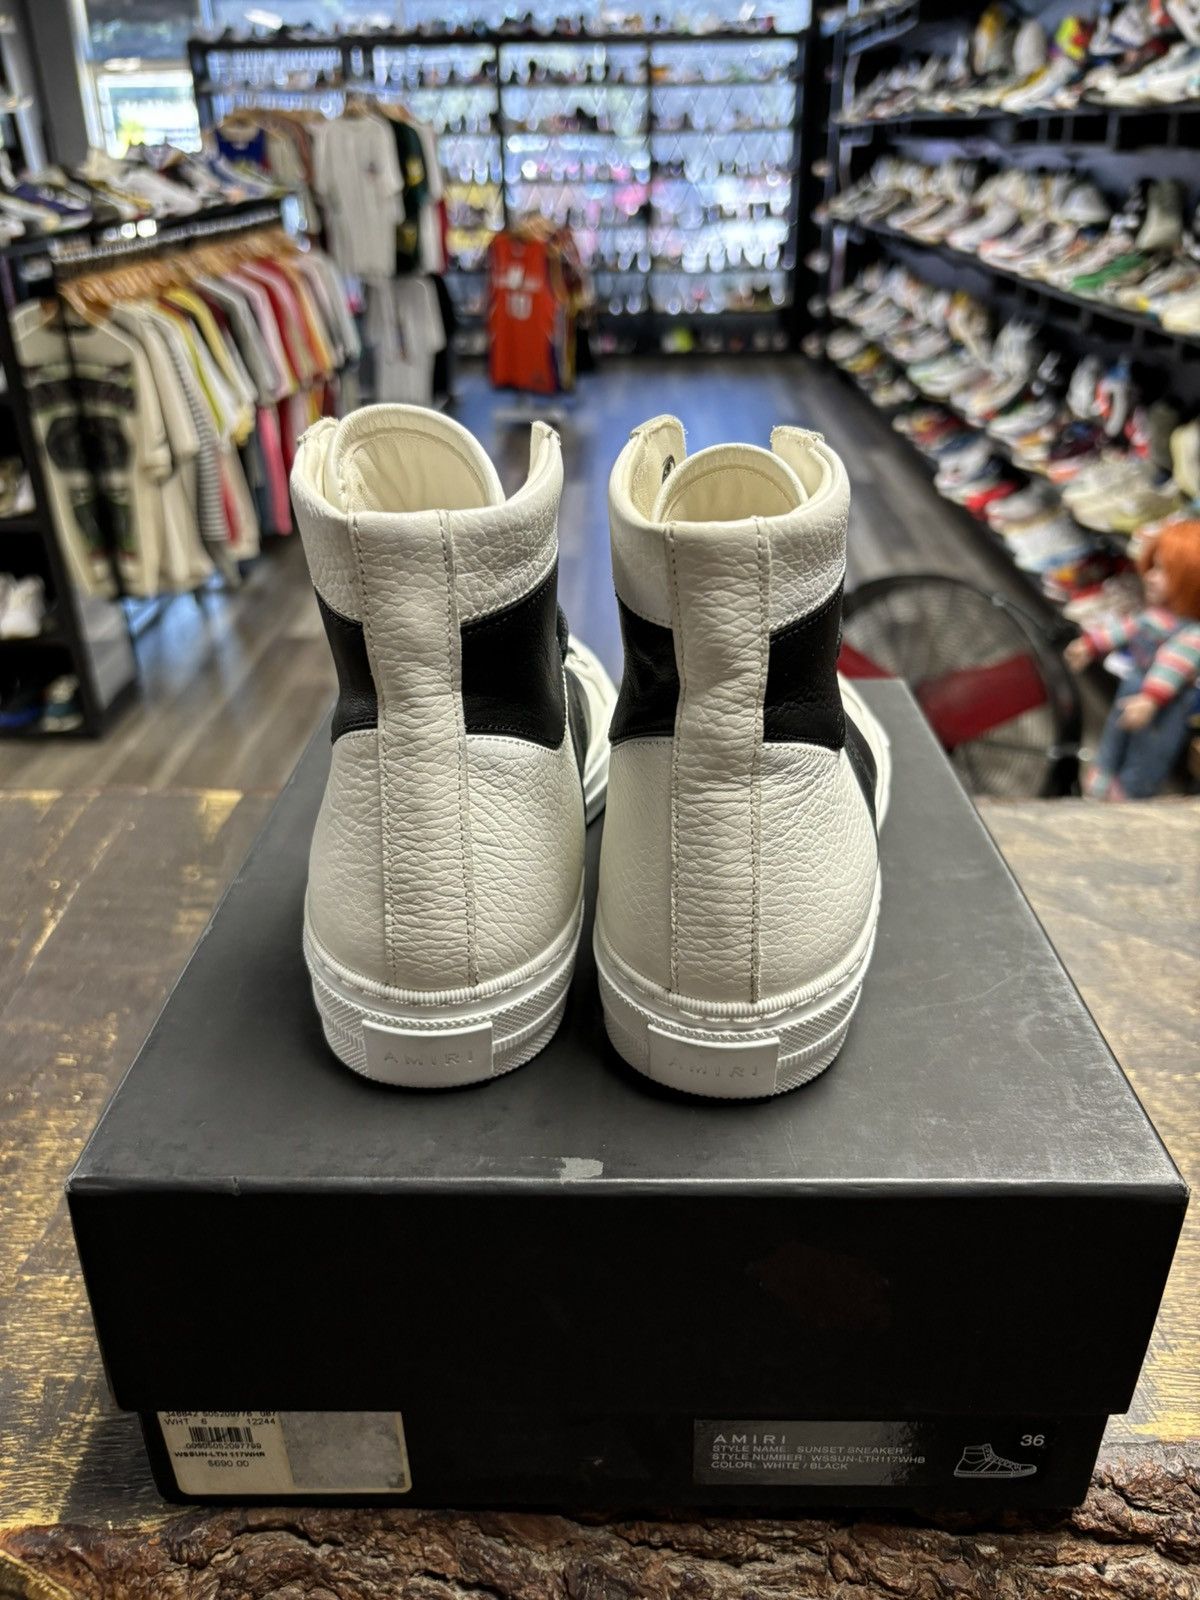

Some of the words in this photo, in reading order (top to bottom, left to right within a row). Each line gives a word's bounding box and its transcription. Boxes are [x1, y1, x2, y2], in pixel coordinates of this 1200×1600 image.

[384, 1050, 474, 1066] AMIRI
[712, 1433, 787, 1445] AMIRI
[1020, 1434, 1046, 1447] 36
[711, 1444, 750, 1453] STYLE
[796, 1446, 845, 1454] SUNSET
[847, 1447, 904, 1455] SNEAKER
[711, 1453, 750, 1461] STYLE
[710, 1461, 757, 1469] COLOR:
[762, 1462, 801, 1470] WHITE
[809, 1463, 849, 1471] BLACK
